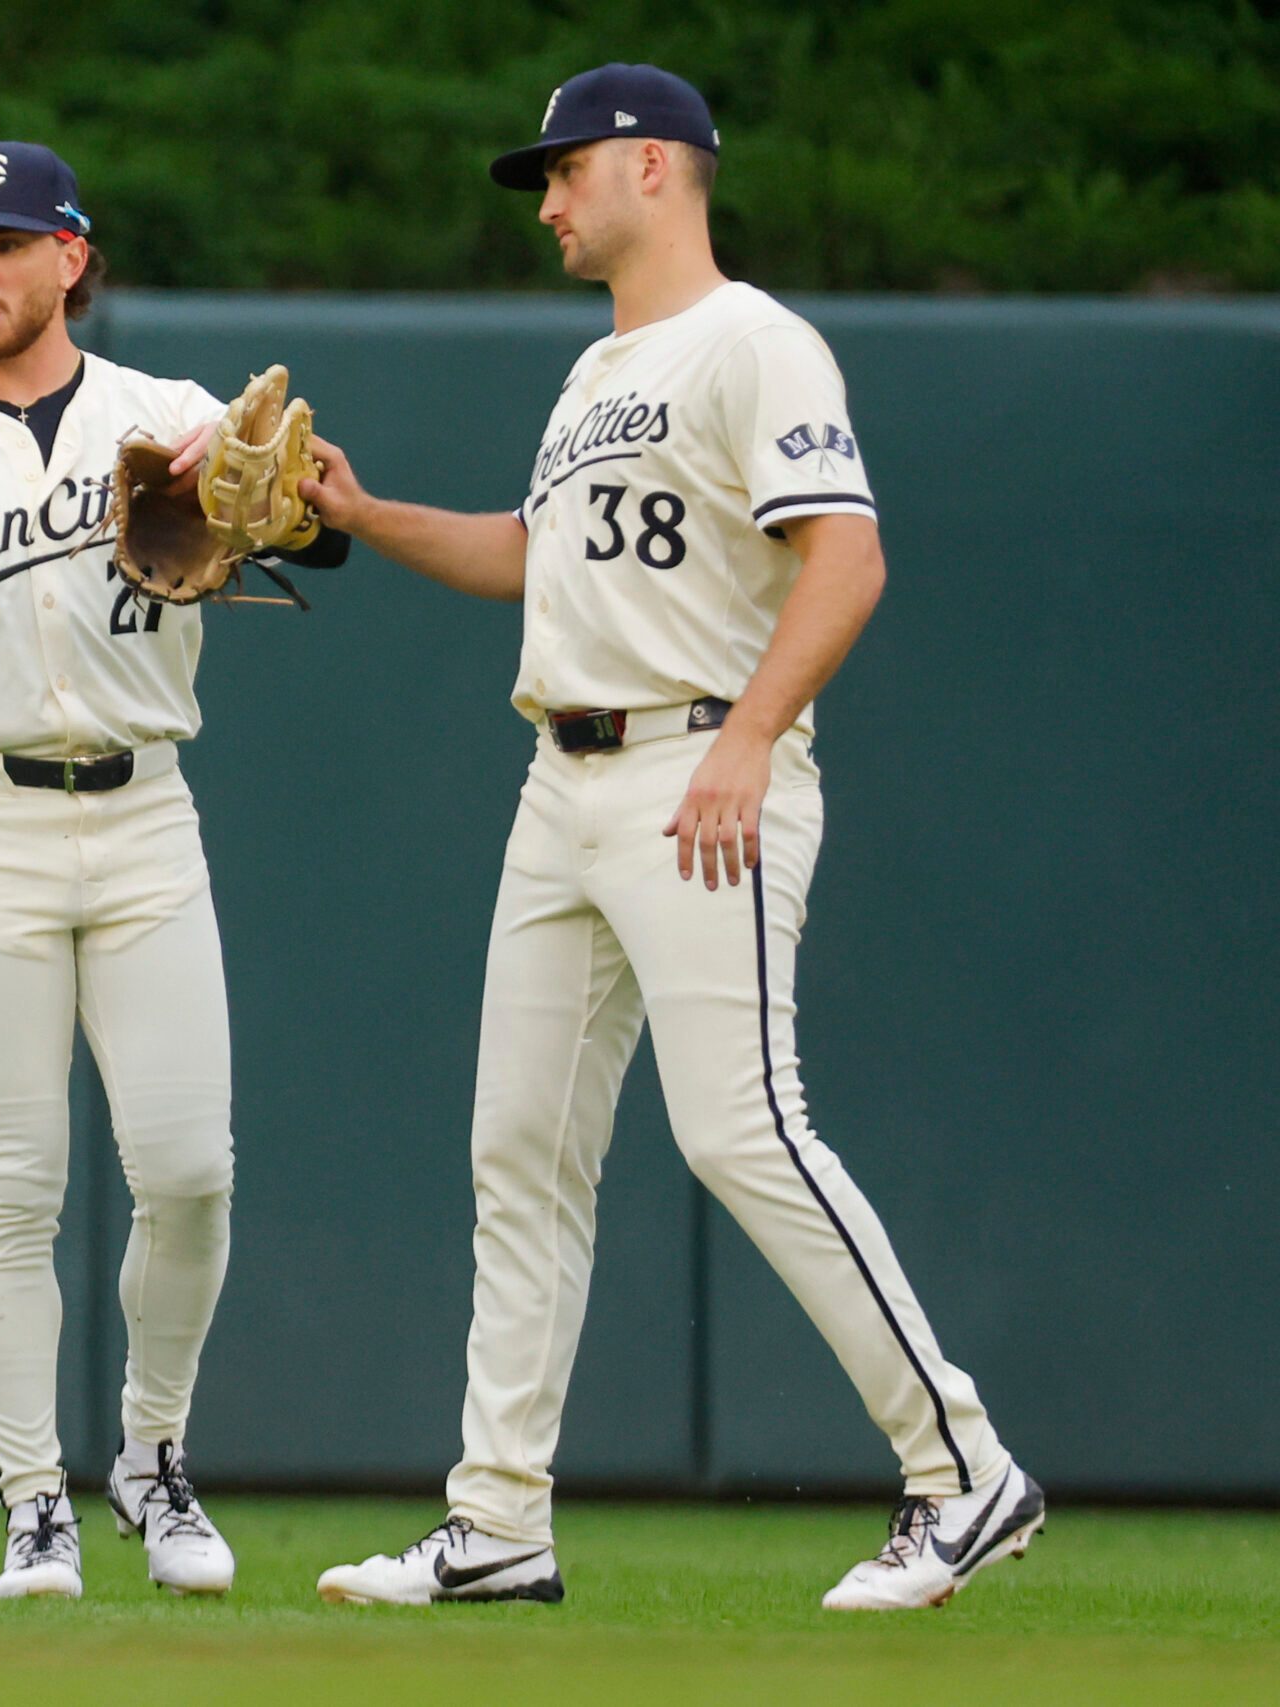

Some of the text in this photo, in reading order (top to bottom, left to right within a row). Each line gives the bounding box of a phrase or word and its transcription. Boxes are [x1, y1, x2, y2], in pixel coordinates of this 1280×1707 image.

[568, 391, 669, 463] Cities
[782, 431, 849, 455] M S
[584, 483, 686, 570] 38
